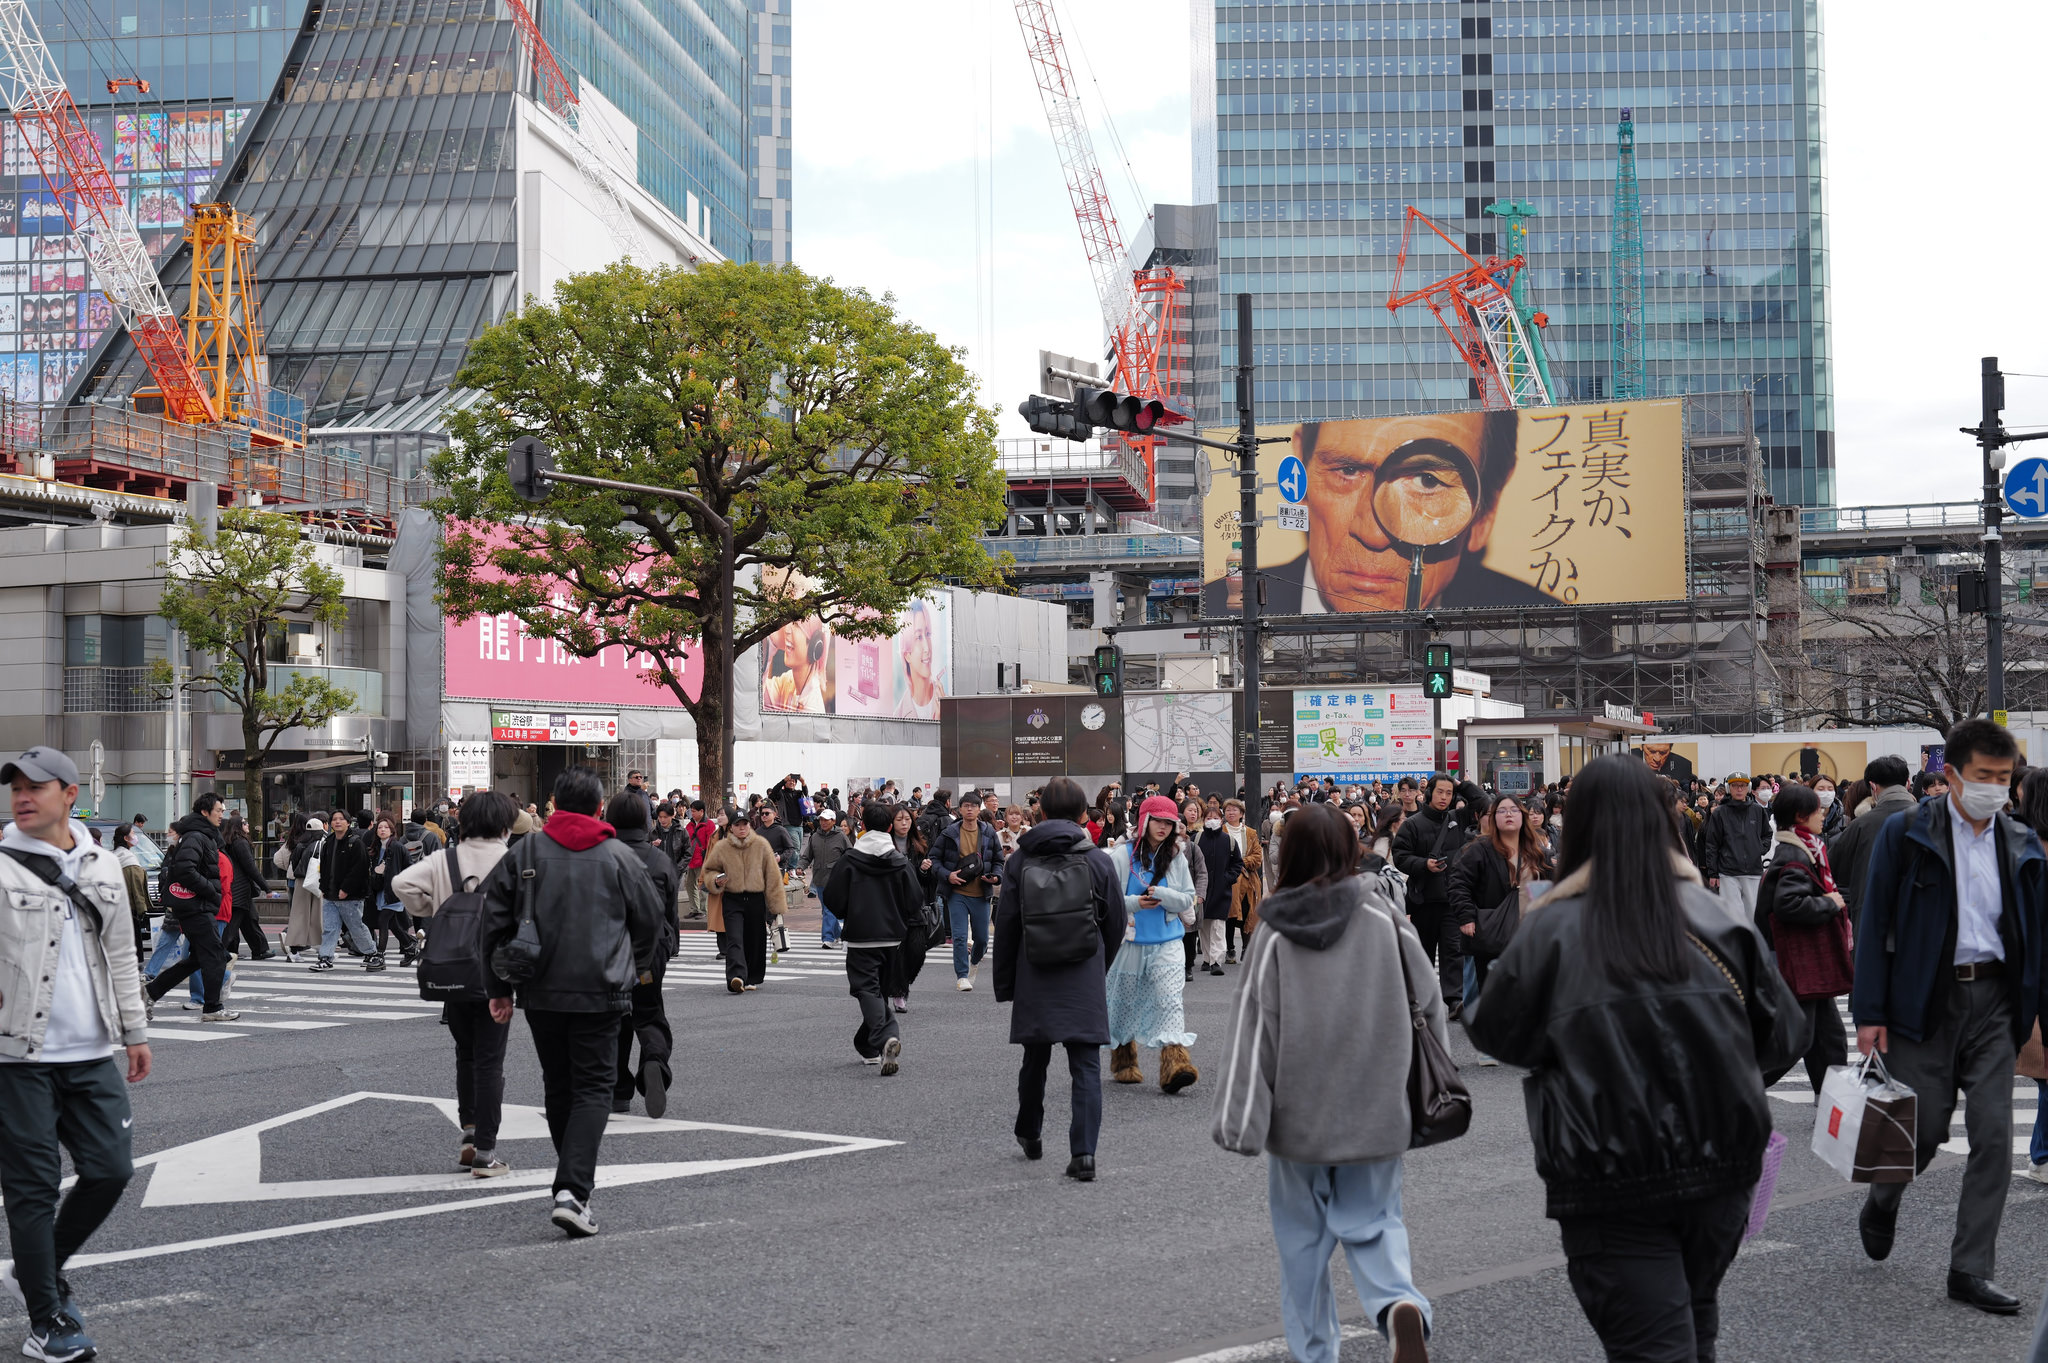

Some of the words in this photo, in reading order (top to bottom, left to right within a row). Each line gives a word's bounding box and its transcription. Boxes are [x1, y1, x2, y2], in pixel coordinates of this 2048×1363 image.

[1581, 409, 1631, 539] 真実か、
[1530, 414, 1578, 603] フェイクか。
[1309, 694, 1374, 706] 確定申告
[498, 714, 509, 723] JR
[512, 715, 532, 726] 渋谷駅
[580, 720, 605, 731] 出口専用
[501, 729, 527, 738] 入口専用
